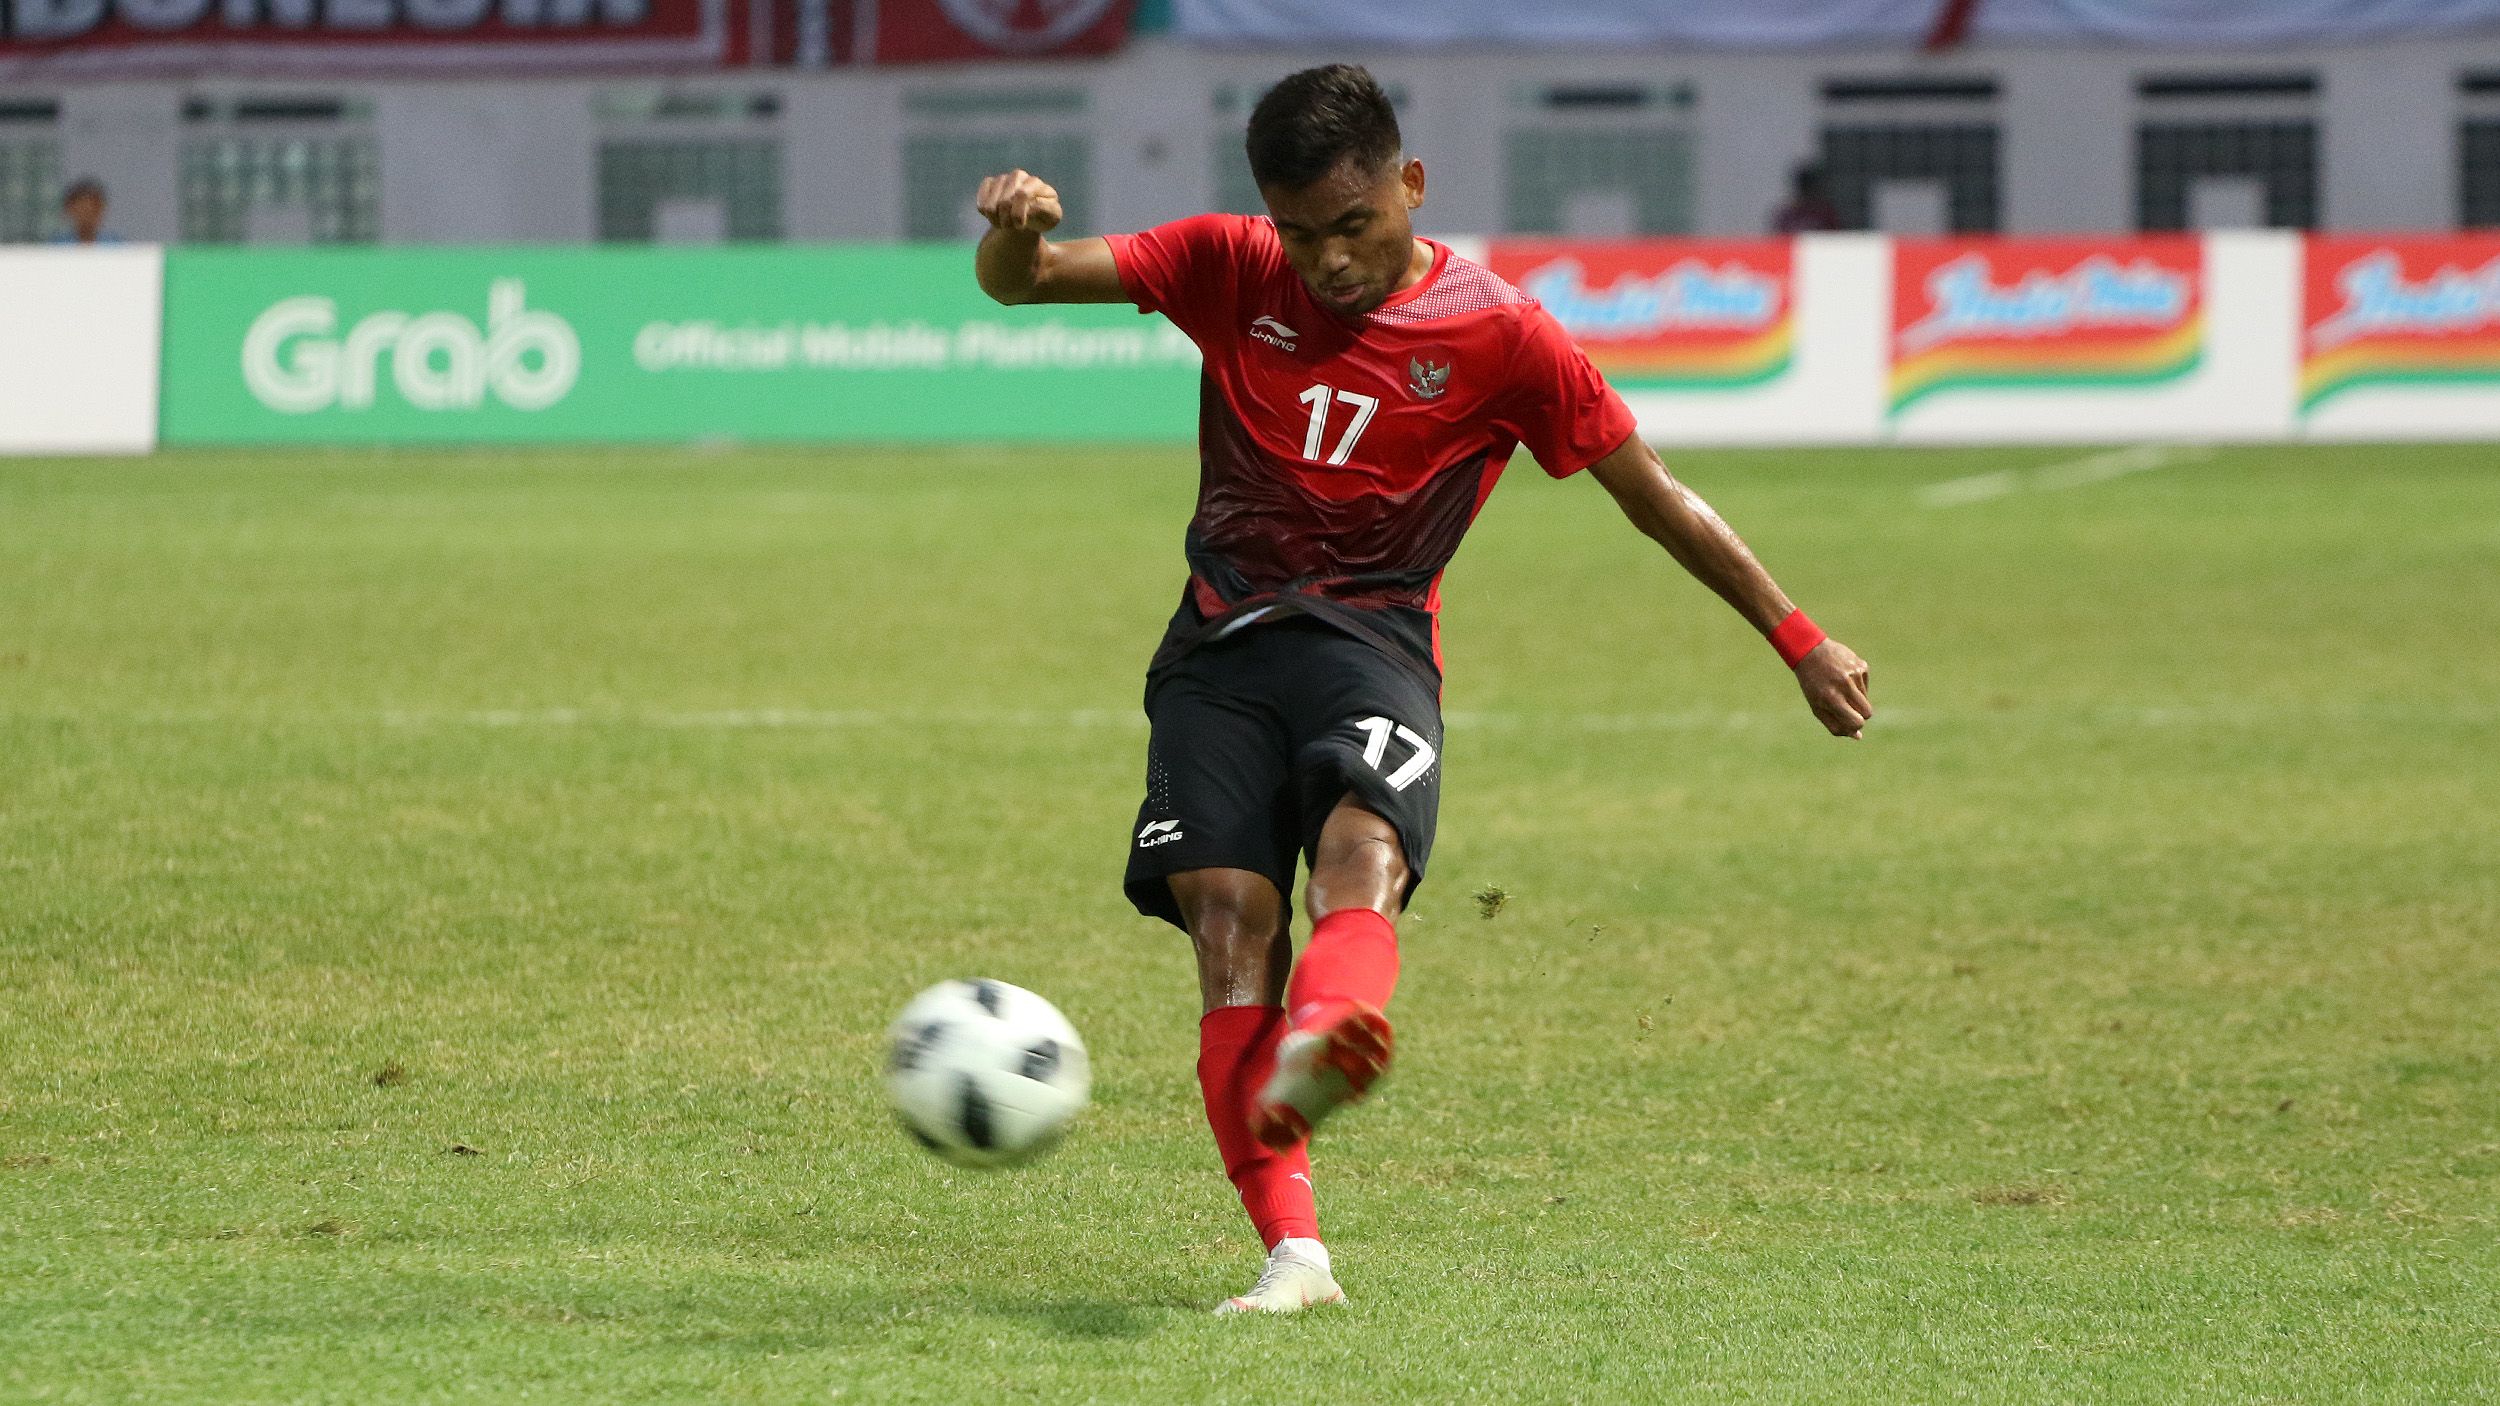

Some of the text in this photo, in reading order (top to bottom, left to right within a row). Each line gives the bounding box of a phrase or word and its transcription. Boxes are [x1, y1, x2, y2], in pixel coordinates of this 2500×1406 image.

[242, 277, 582, 413] Grab
[1249, 327, 1298, 352] LI-NING
[1298, 383, 1380, 466] 17
[1354, 715, 1436, 792] 17
